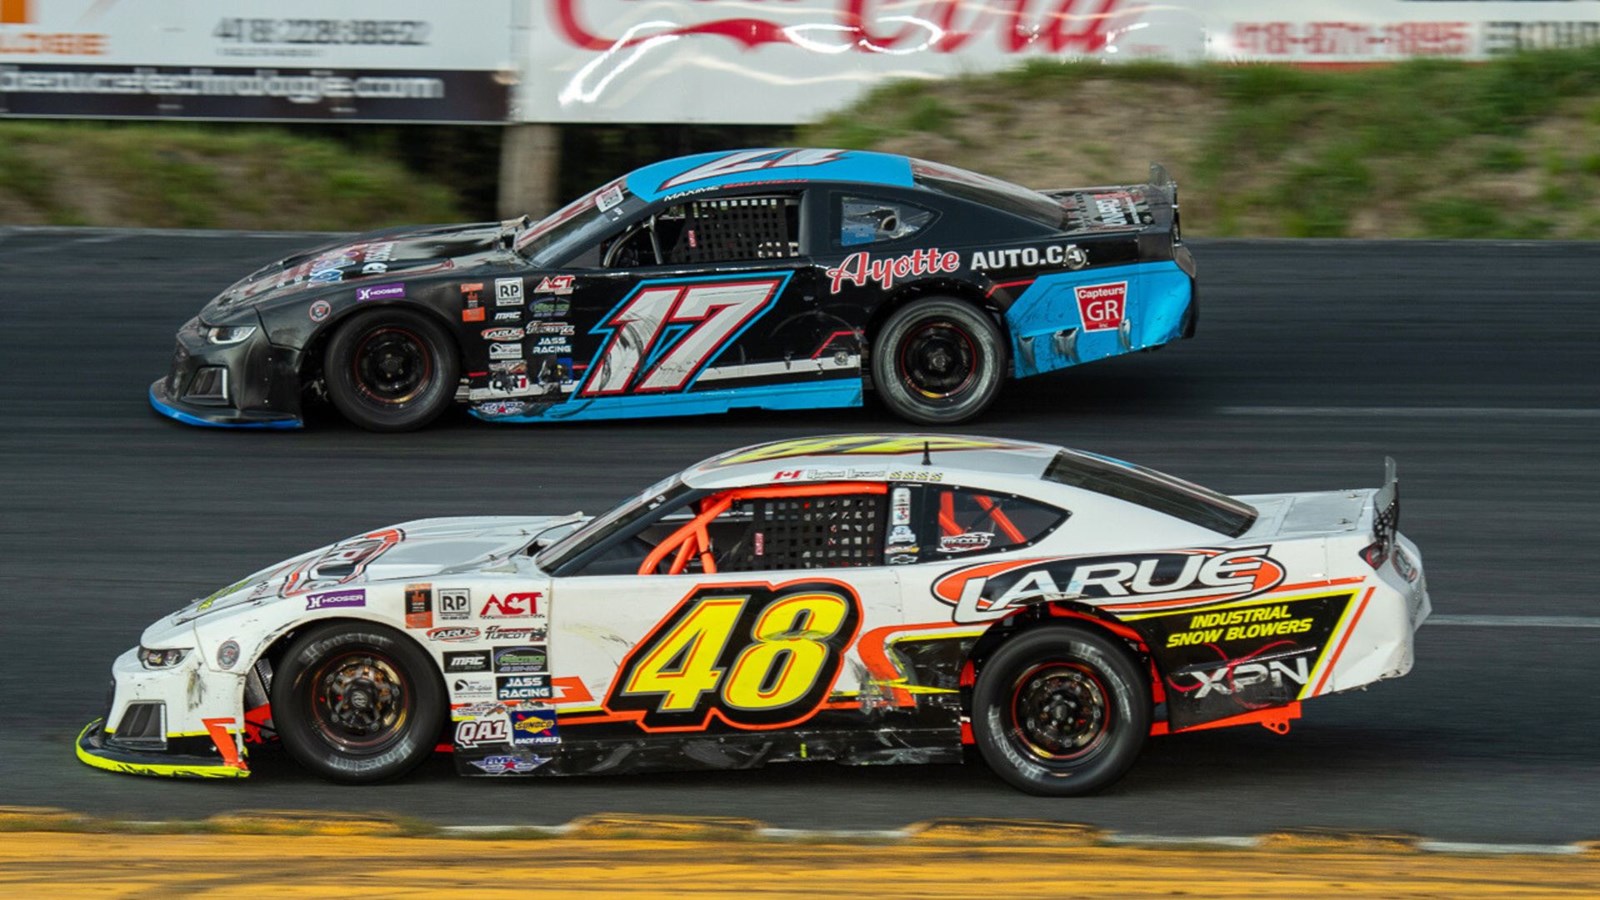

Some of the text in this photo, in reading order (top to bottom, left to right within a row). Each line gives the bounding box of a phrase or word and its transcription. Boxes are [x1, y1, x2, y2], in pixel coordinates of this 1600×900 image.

[826, 244, 1082, 294] Ayotte AUTO.CA
[370, 287, 403, 296] HOOSIER
[500, 284, 519, 298] RP
[533, 274, 576, 293] ACT
[1078, 287, 1125, 299] Capteurs
[1087, 300, 1120, 321] GR
[538, 336, 567, 345] JASS
[580, 279, 781, 396] 17
[532, 345, 573, 354] RACING
[951, 545, 1273, 625] LARUE
[322, 593, 364, 604] HOOSIER
[442, 595, 467, 611] RP
[480, 591, 544, 616] ACT
[1189, 605, 1292, 629] INDUSTRIAL
[1166, 618, 1313, 648] SNOW BLOWERS
[618, 590, 850, 714] 48
[451, 656, 486, 666] MAC
[506, 677, 542, 687] JASS
[1190, 657, 1309, 699] XPN
[500, 687, 550, 698] RACING
[458, 719, 508, 746] QA1
[516, 720, 554, 729] SUNOCO
